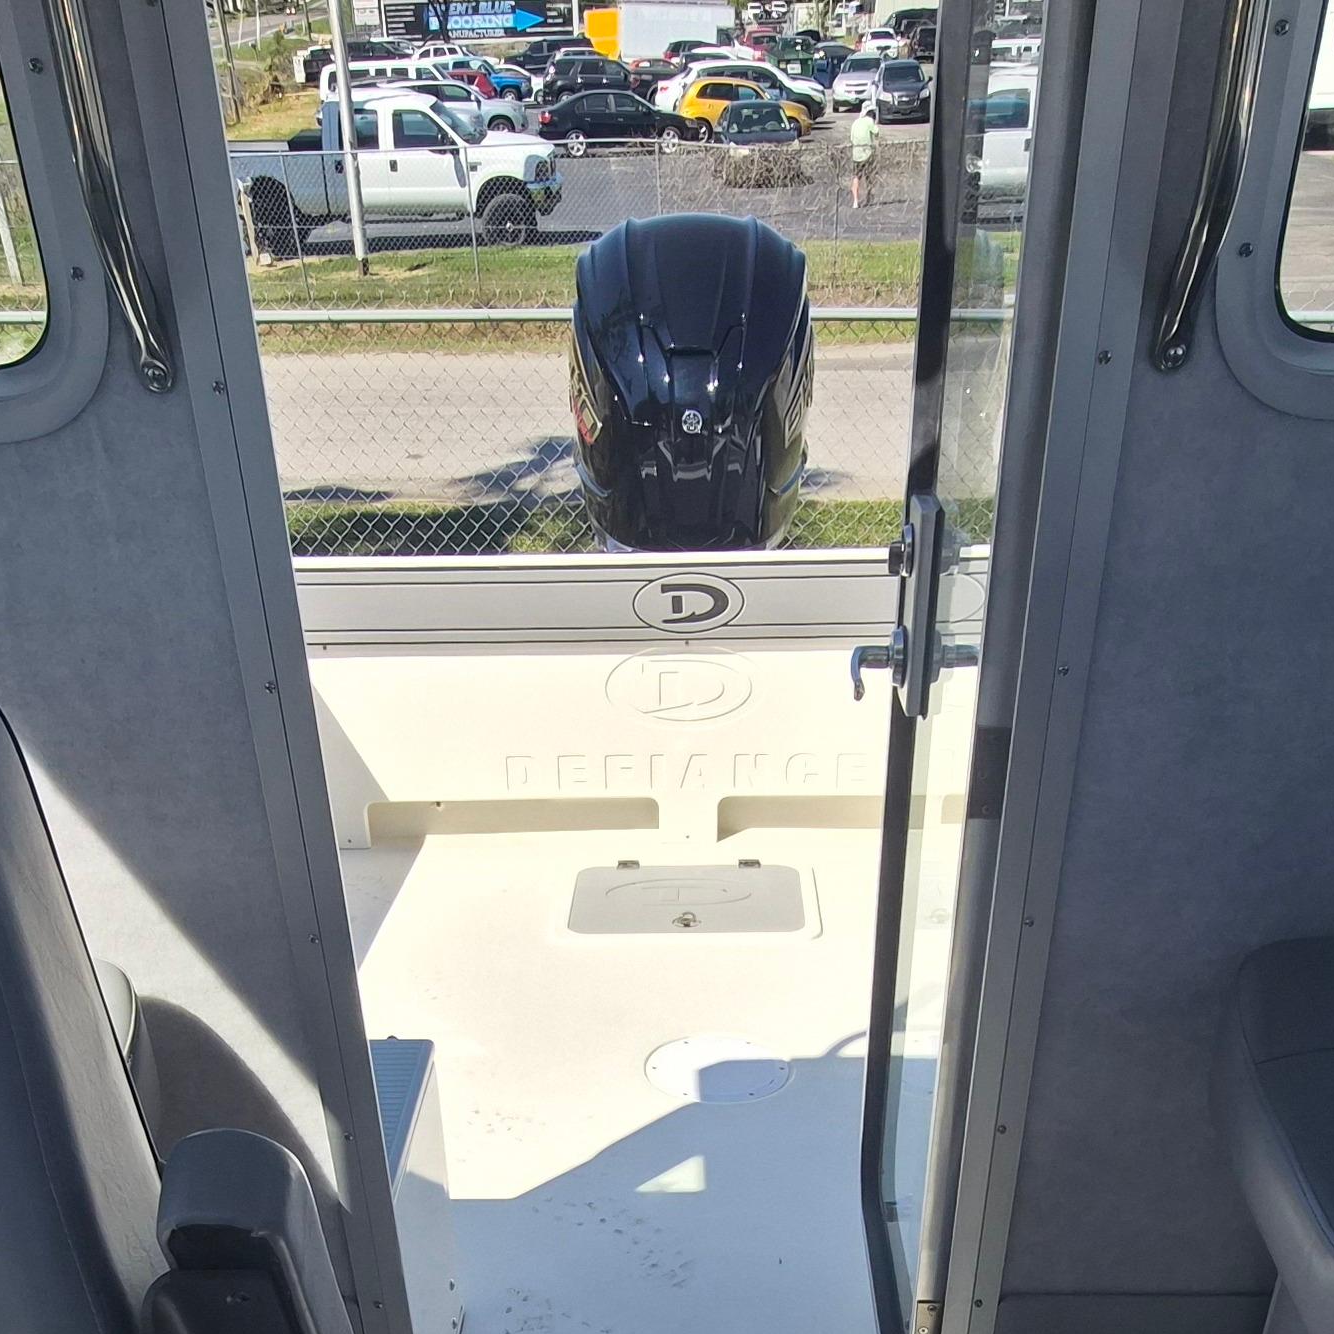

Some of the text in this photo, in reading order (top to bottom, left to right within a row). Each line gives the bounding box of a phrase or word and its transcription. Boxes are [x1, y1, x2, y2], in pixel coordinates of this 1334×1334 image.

[479, 1, 515, 14] BLUE
[429, 14, 514, 30] OORING
[440, 29, 506, 38] ANUFACTURER
[661, 583, 729, 624] D
[505, 752, 868, 790] DEFIANCE
